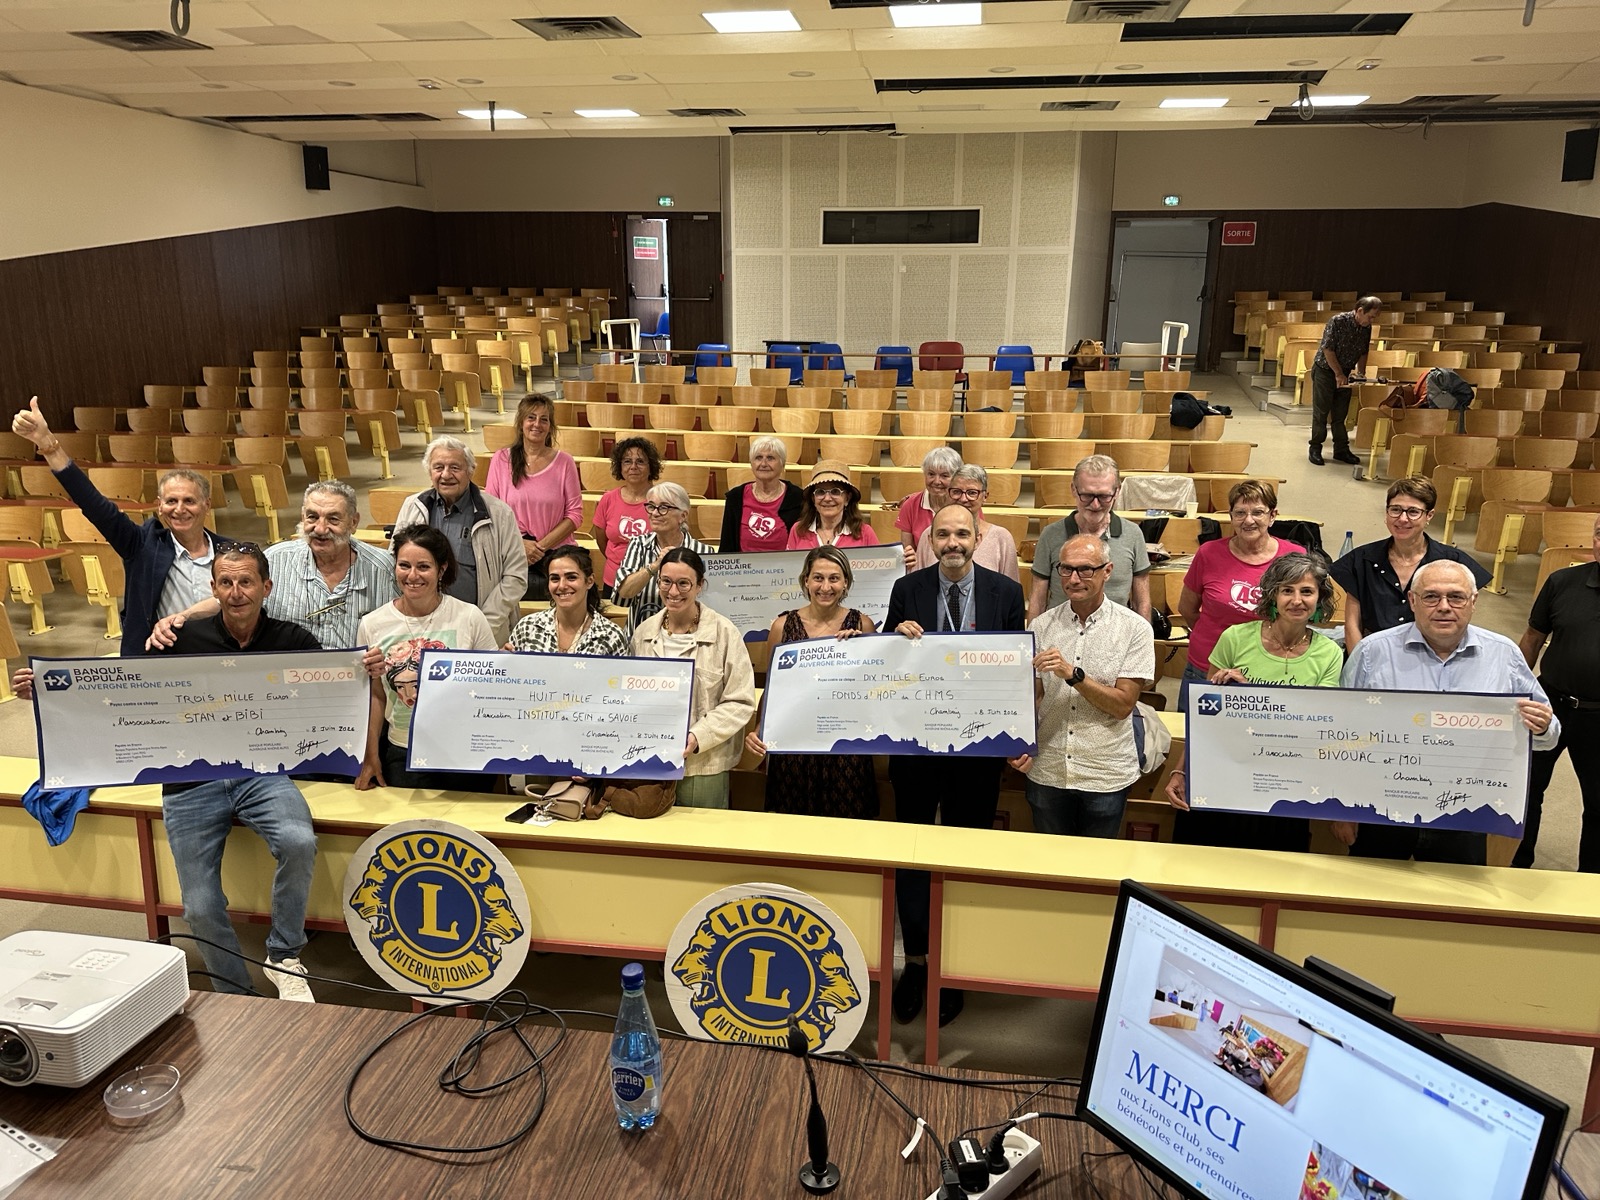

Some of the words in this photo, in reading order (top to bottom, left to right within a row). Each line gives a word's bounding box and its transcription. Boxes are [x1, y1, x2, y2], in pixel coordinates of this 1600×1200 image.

[623, 520, 642, 537] 4S
[752, 517, 771, 533] 4S
[707, 558, 741, 566] BANQUE
[708, 563, 752, 571] POPULAIRE
[771, 577, 795, 586] HUIT
[1236, 586, 1262, 605] 4S
[800, 646, 835, 655] BANQUE
[800, 652, 847, 662] POPULAIRE
[455, 660, 494, 668] BANQUE
[799, 660, 835, 668] AUVERGNE
[73, 667, 123, 676] BANQUE
[287, 670, 354, 684] 3000,00
[454, 667, 507, 677] POPULAIRE
[919, 673, 945, 681] Euros
[75, 673, 142, 683] POPULAIRE
[452, 676, 493, 684] AUVERGNE
[495, 676, 521, 685] RHÔNE
[523, 678, 547, 686] ALPES
[77, 682, 128, 691] AUVERGNE
[130, 680, 162, 690] RHÔNE
[164, 680, 192, 688] ALPES
[627, 677, 676, 692] 8000,00
[266, 693, 289, 702] Euros
[529, 691, 557, 702] HUIT
[831, 690, 862, 700] FONDS
[1225, 694, 1270, 704] BANQUE
[1225, 702, 1286, 713] POPULAIRE
[184, 712, 216, 724] STAN
[518, 709, 560, 720] INSTITUT
[608, 712, 639, 723] SAVOIE
[1225, 711, 1272, 720] AUVERGNE
[1274, 712, 1304, 722] RHÔNE
[1306, 714, 1334, 723] ALPES
[1433, 713, 1503, 730] 3000,00
[1422, 735, 1455, 747] Euros
[1383, 756, 1395, 765] et
[1456, 777, 1462, 785] 8
[1486, 779, 1508, 788] 2026
[386, 837, 487, 879] LIONS
[417, 881, 460, 941] L
[716, 902, 825, 946] LIONS
[389, 946, 484, 982] INTERNATIONAL
[745, 947, 791, 1009] L
[1125, 1050, 1246, 1153] MERCI
[1117, 1098, 1171, 1146] bénévoles
[1173, 1142, 1184, 1156] et
[1120, 1086, 1140, 1105] aux
[1141, 1098, 1172, 1128] Lions
[1174, 1122, 1203, 1152] Club,
[1206, 1146, 1225, 1165] ses
